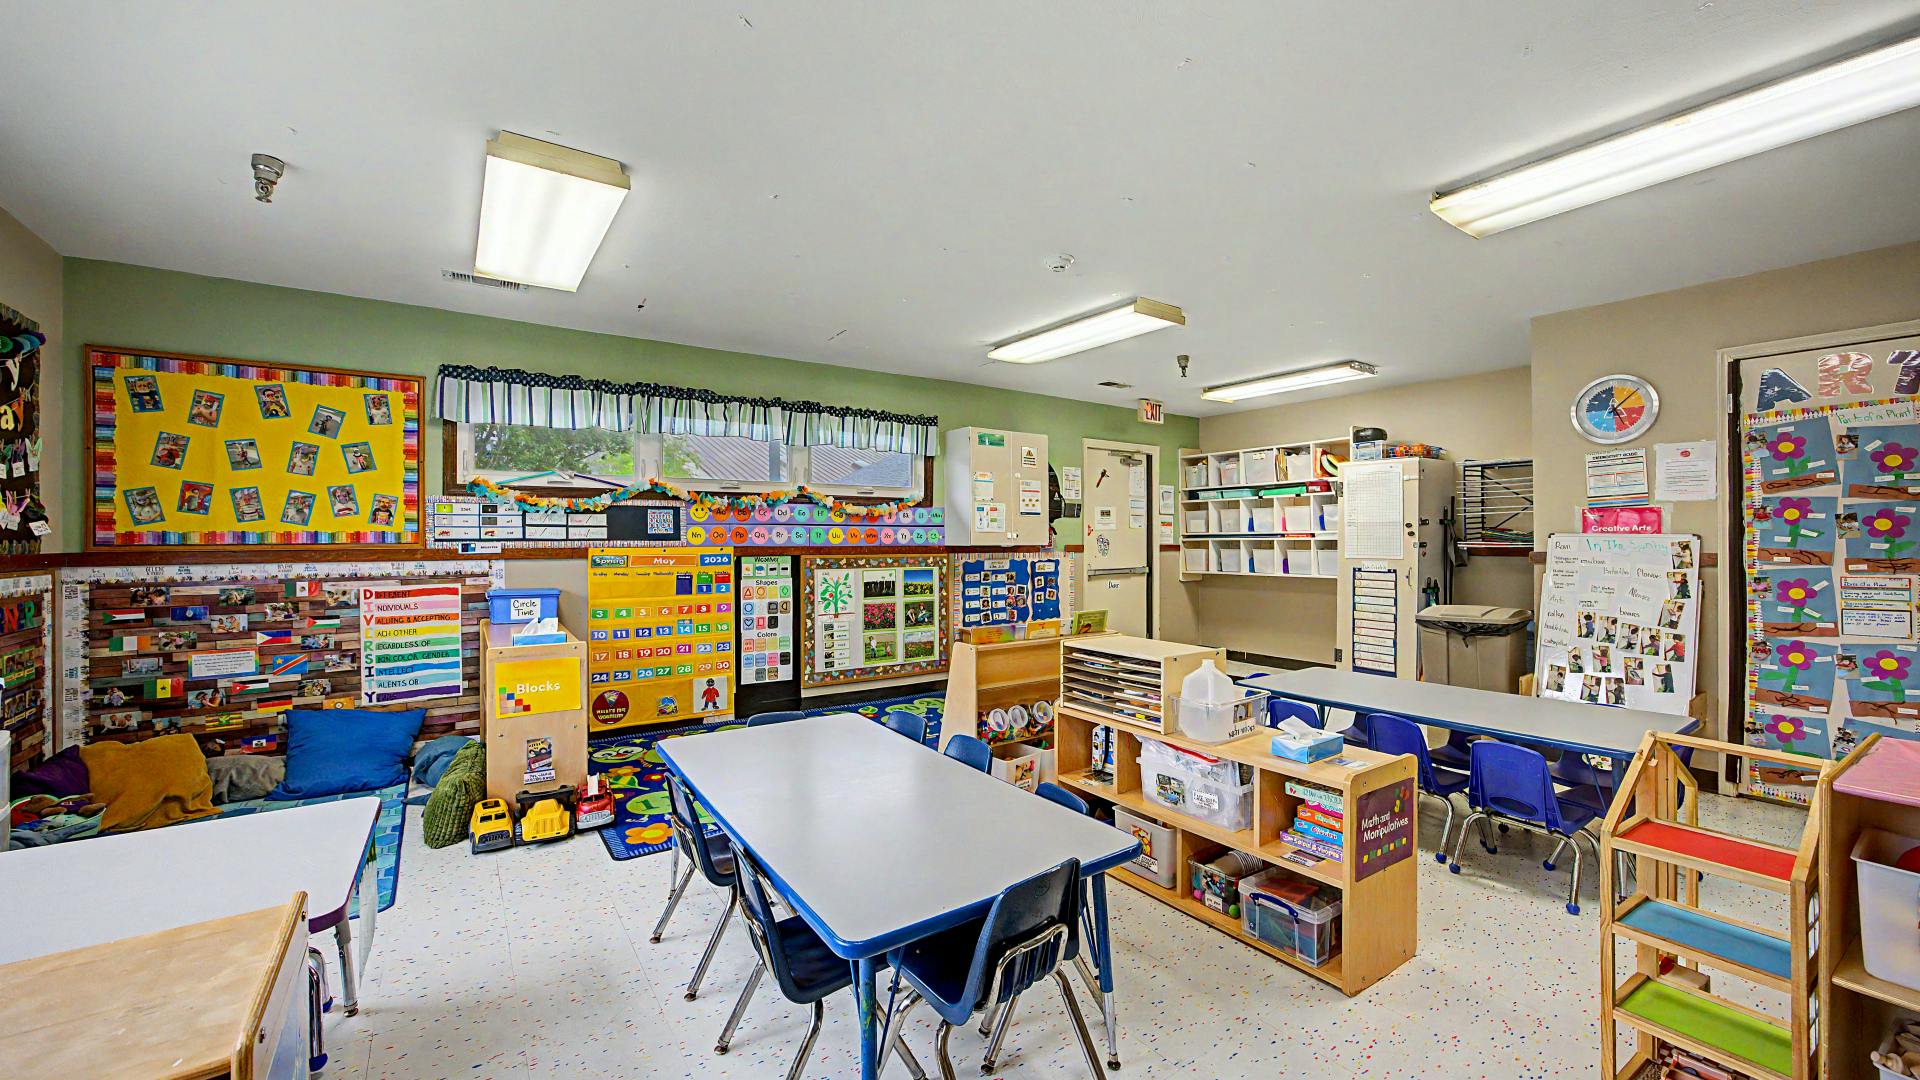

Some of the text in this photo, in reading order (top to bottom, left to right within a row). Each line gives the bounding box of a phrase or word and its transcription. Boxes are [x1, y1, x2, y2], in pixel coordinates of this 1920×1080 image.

[1145, 401, 1162, 421] EXIT
[653, 557, 675, 565] May
[513, 600, 537, 608] Circle
[514, 608, 535, 616] Time
[593, 631, 606, 639] 10
[616, 630, 626, 638] 11
[640, 649, 651, 657] 19
[592, 674, 608, 682] 24
[516, 681, 561, 695] Blocks
[1361, 813, 1380, 830] Math
[1363, 817, 1409, 843] Manipulatives
